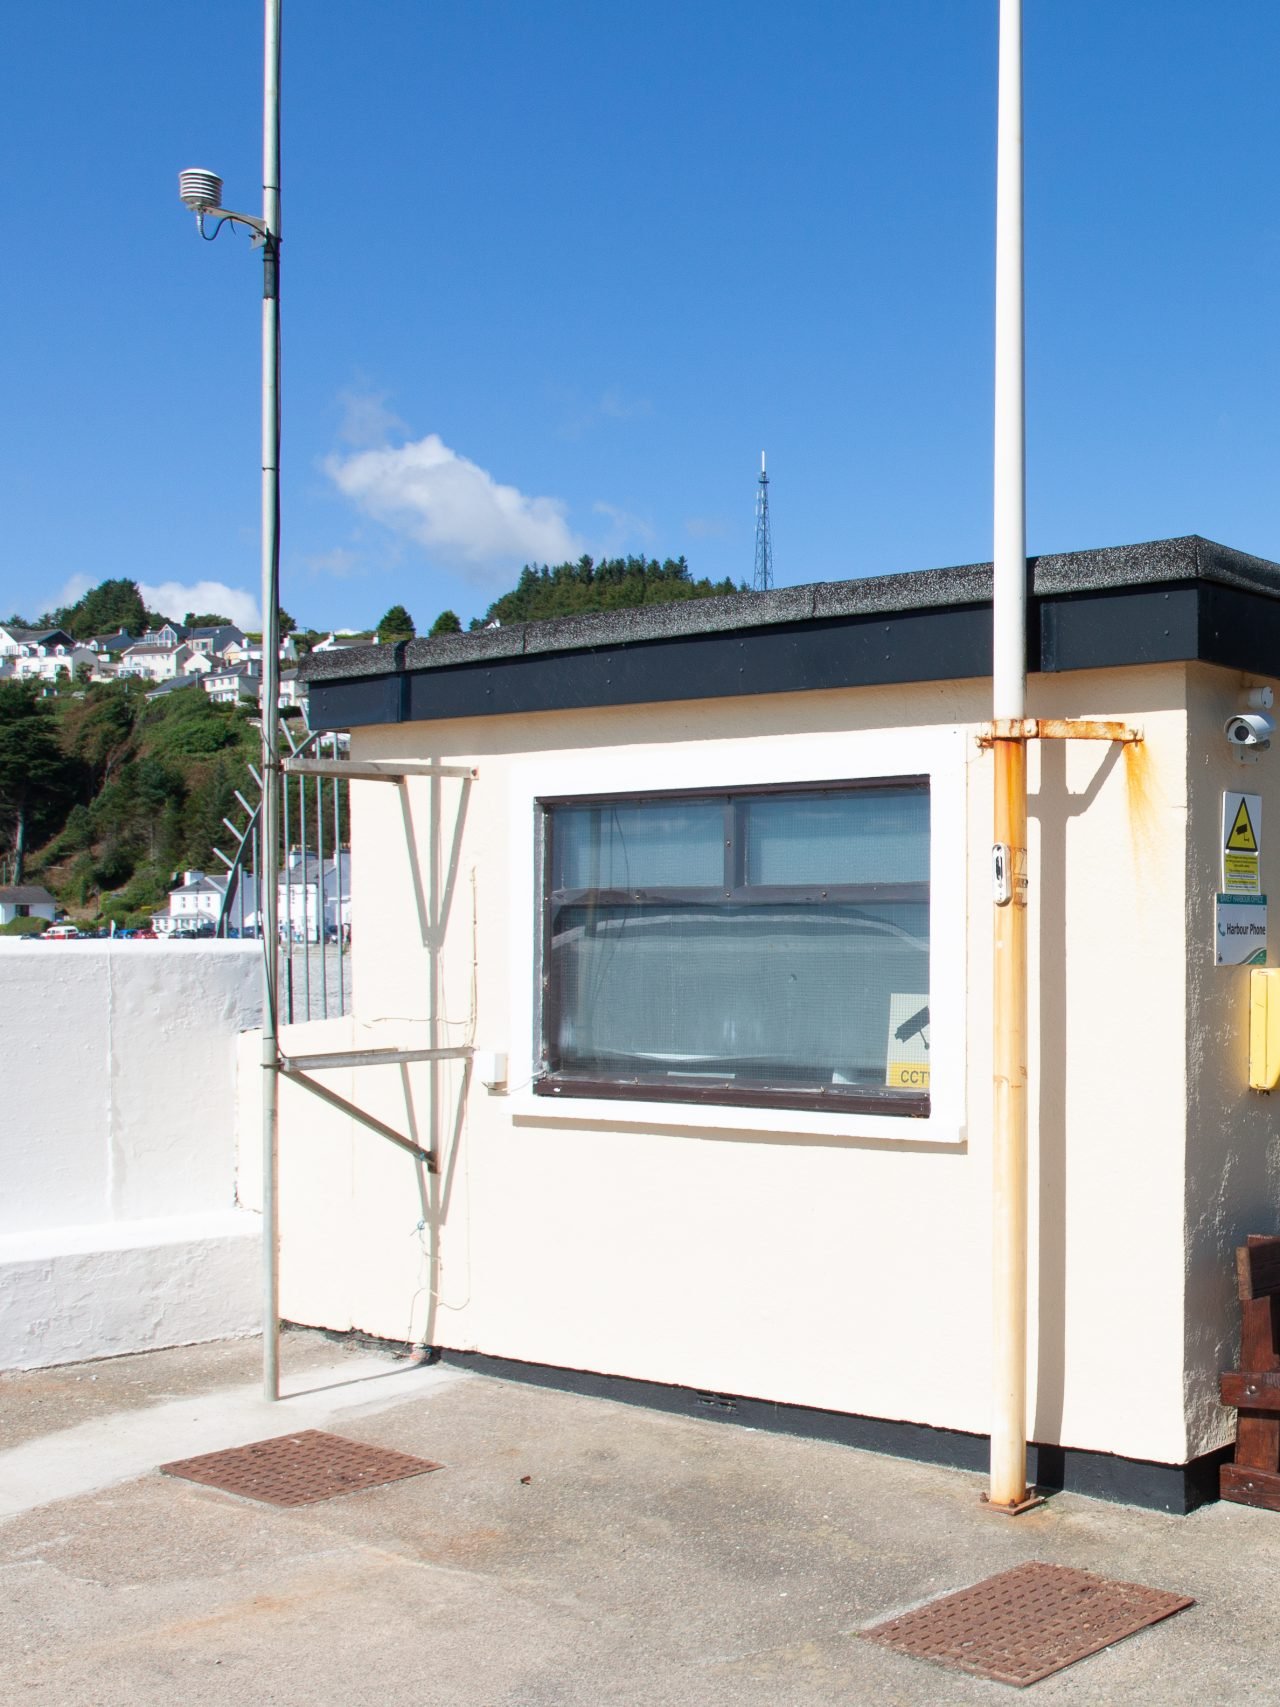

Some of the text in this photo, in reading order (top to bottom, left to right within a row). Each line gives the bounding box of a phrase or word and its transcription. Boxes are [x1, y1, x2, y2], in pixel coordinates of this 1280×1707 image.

[1226, 923, 1266, 935] Harbour Phone
[900, 1070, 930, 1084] CCT
